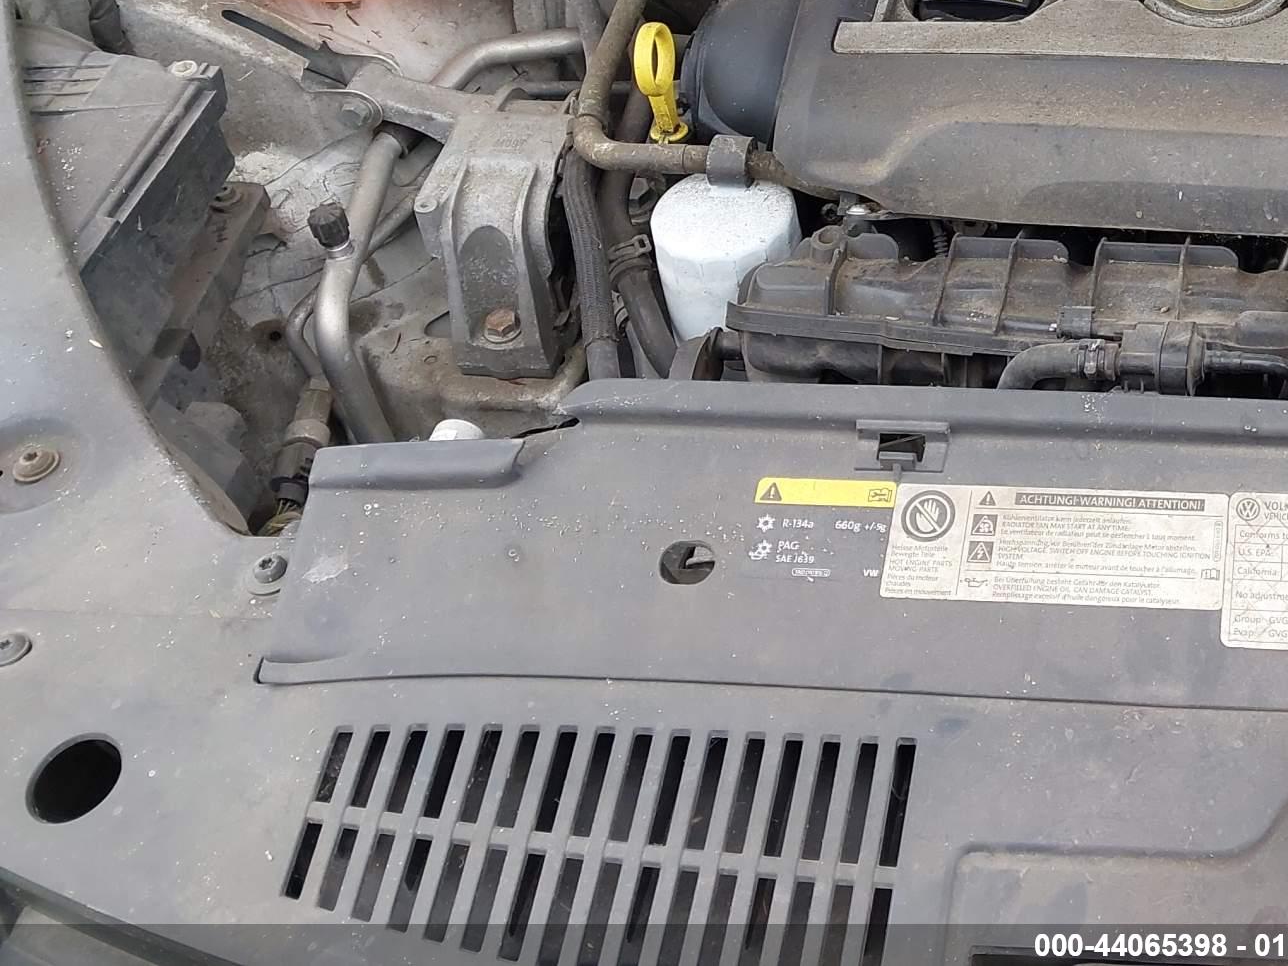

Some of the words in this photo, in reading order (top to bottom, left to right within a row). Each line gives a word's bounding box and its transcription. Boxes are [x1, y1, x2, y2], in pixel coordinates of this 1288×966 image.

[782, 518, 815, 530] R-134a
[834, 520, 861, 534] 660g
[777, 540, 800, 551] PAG
[775, 554, 793, 564] SAE
[793, 553, 815, 565] J639
[863, 568, 879, 577] VW
